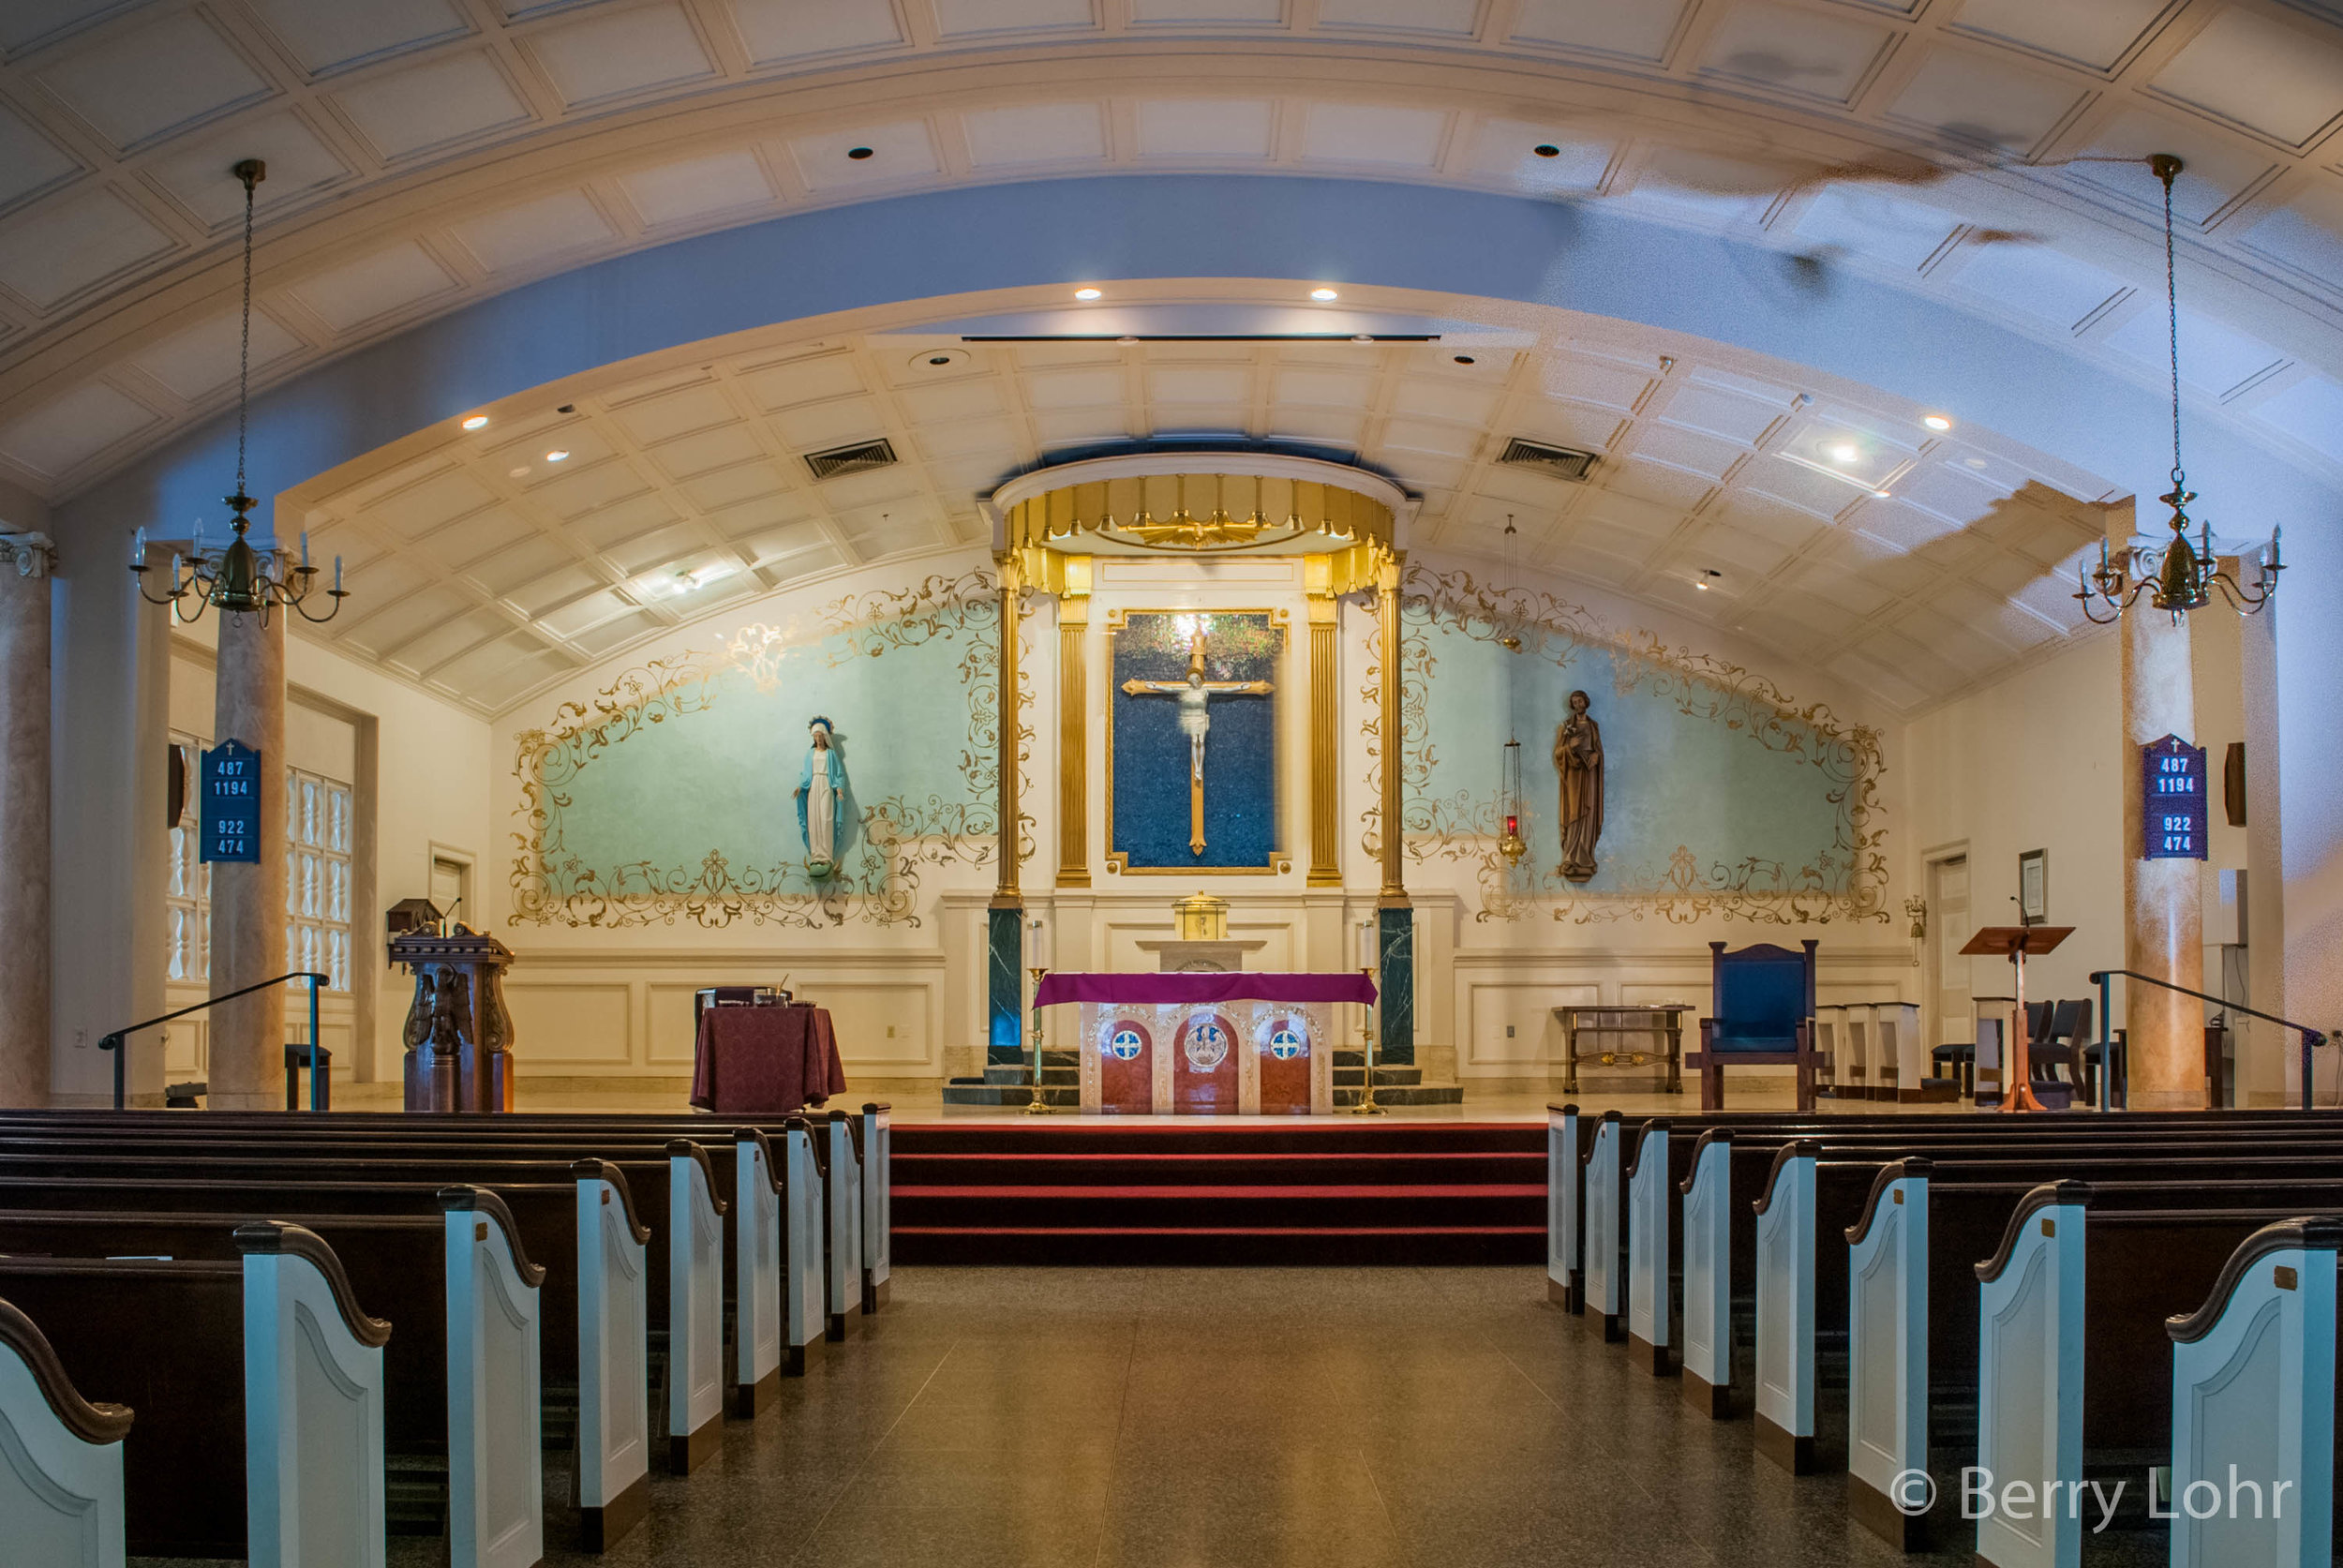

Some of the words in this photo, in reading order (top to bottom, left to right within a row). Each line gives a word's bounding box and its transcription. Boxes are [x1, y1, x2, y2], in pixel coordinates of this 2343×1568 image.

[217, 761, 243, 775] 487
[2160, 757, 2188, 772] 487
[215, 781, 247, 795] 1194
[2158, 777, 2194, 792] 1194
[218, 820, 244, 834] 922
[2163, 816, 2191, 831] 922
[218, 839, 244, 854] 474
[2163, 836, 2191, 851] 474
